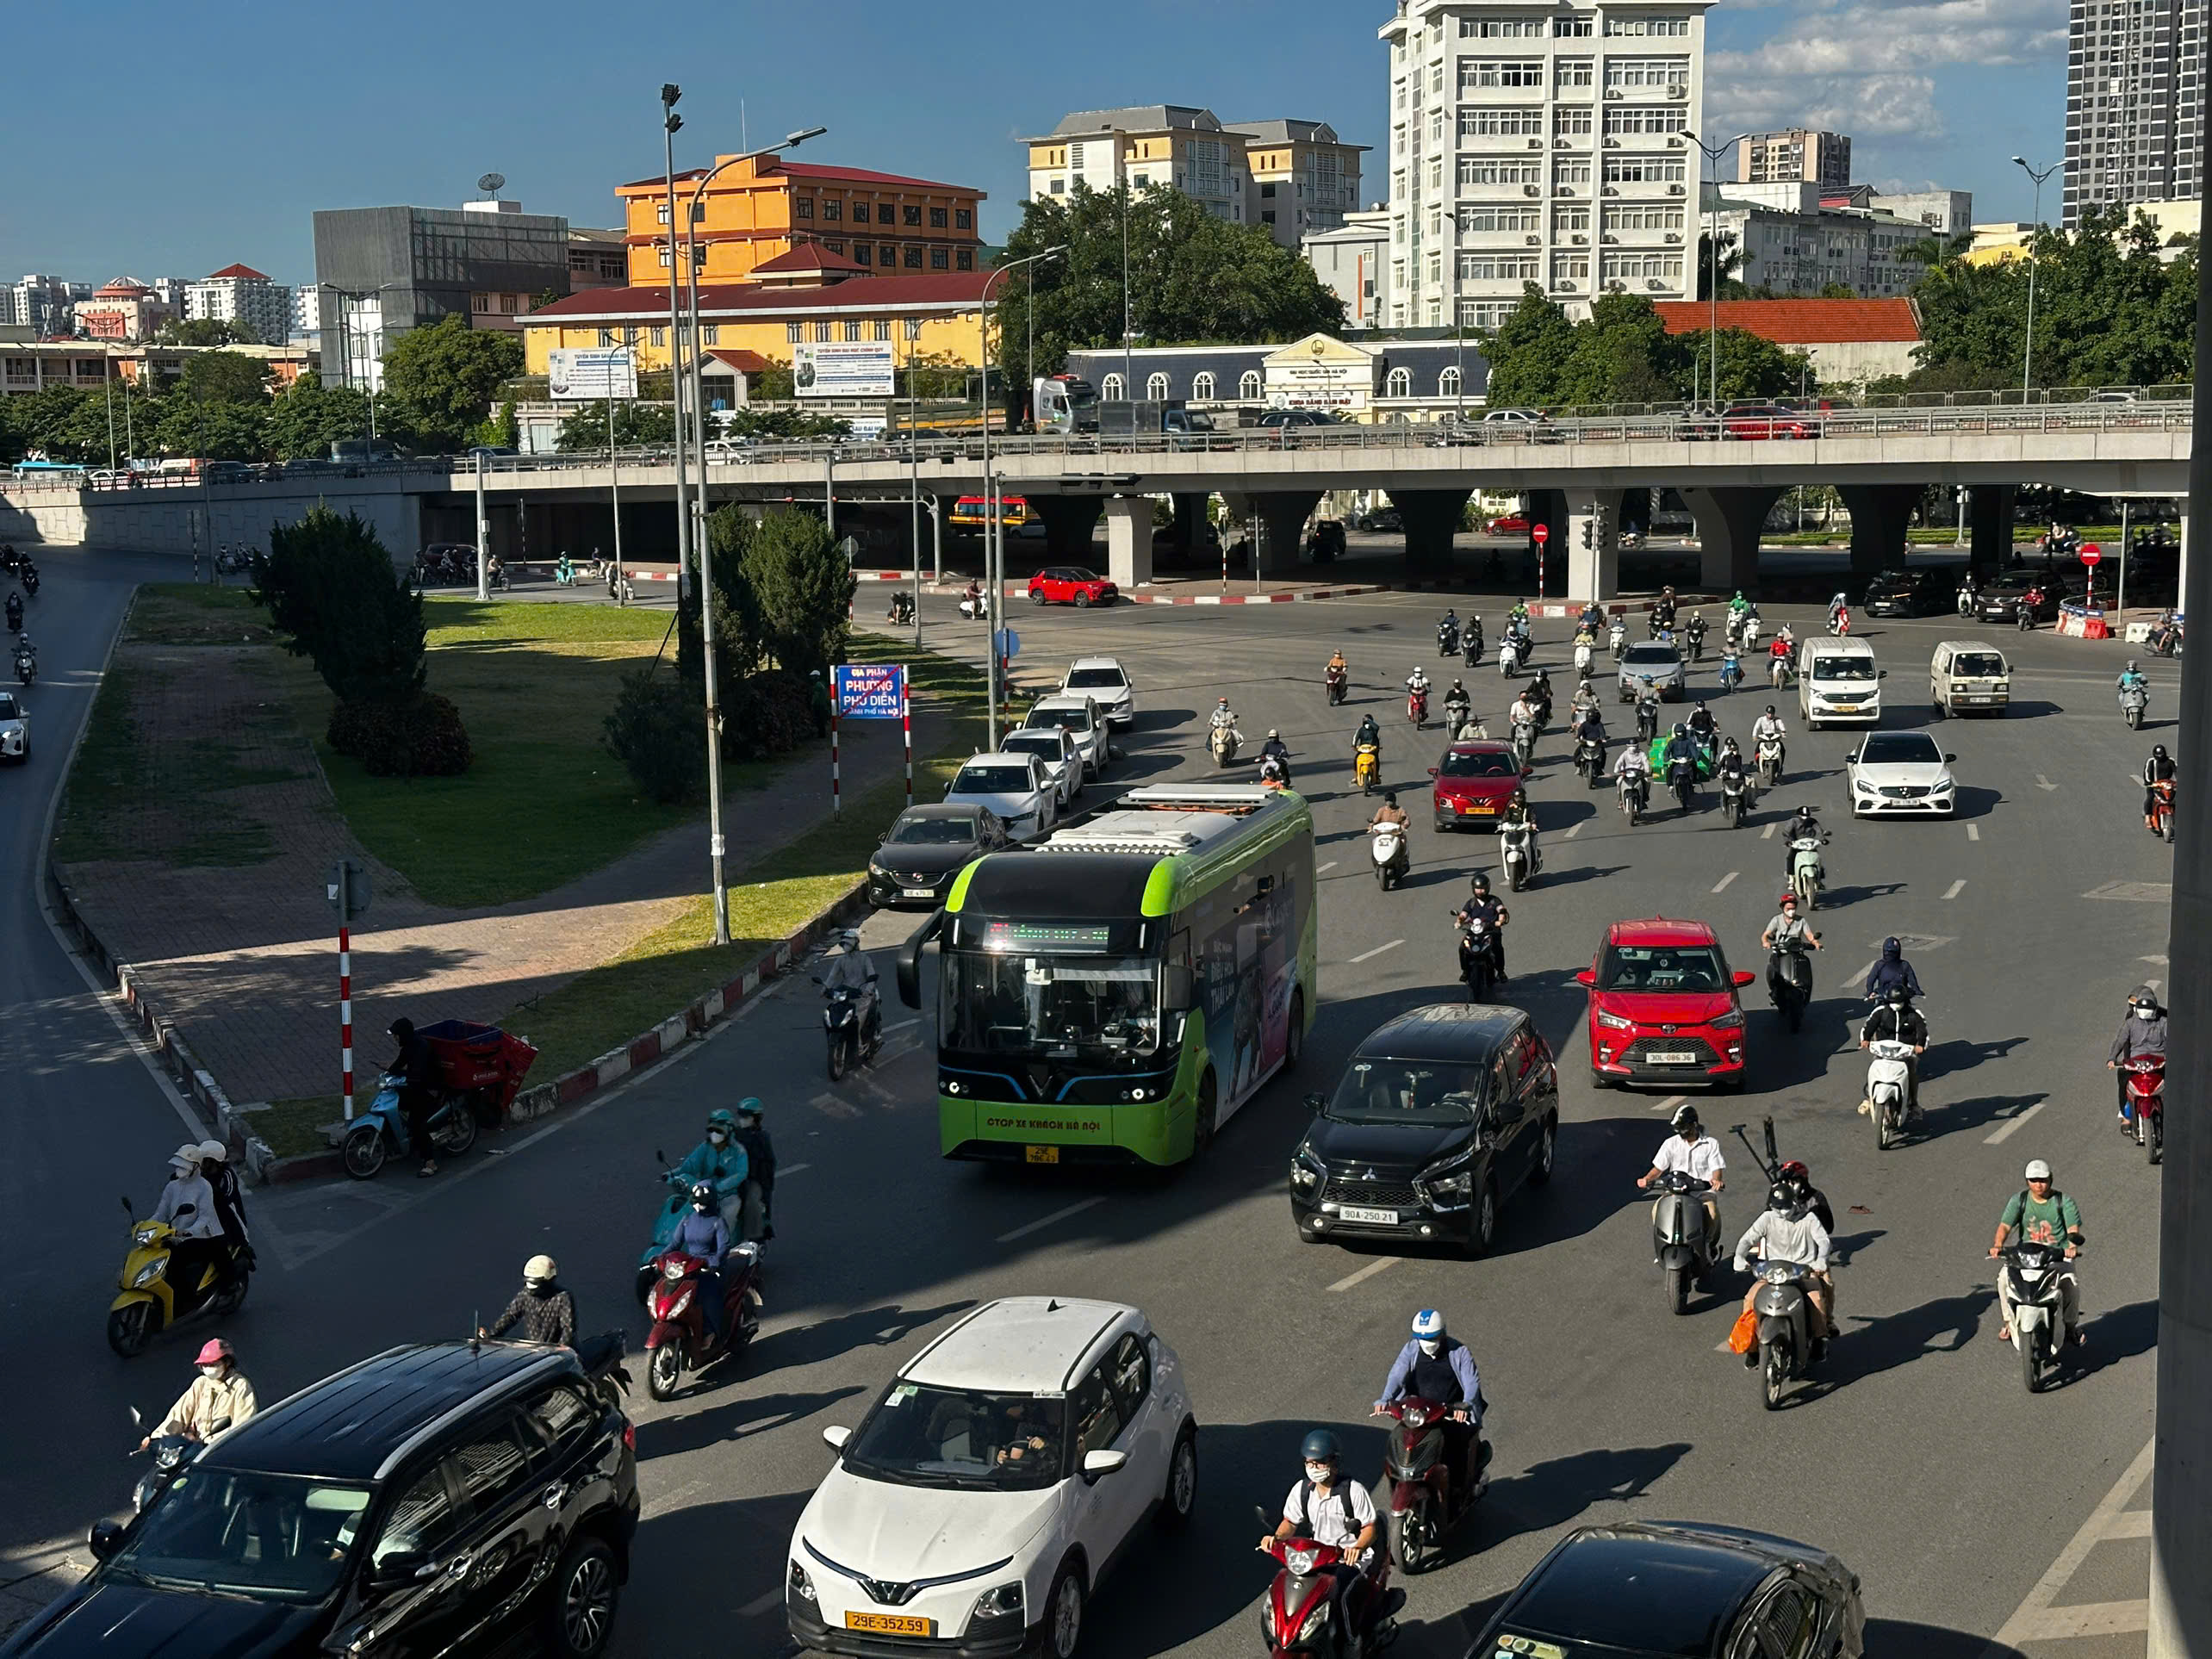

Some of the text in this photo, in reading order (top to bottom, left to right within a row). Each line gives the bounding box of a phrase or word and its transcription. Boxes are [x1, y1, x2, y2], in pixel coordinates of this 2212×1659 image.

[843, 692, 867, 706] PHÚ
[1029, 1119, 1064, 1130] KHÁCH
[853, 1614, 923, 1632] 29E-352.59
